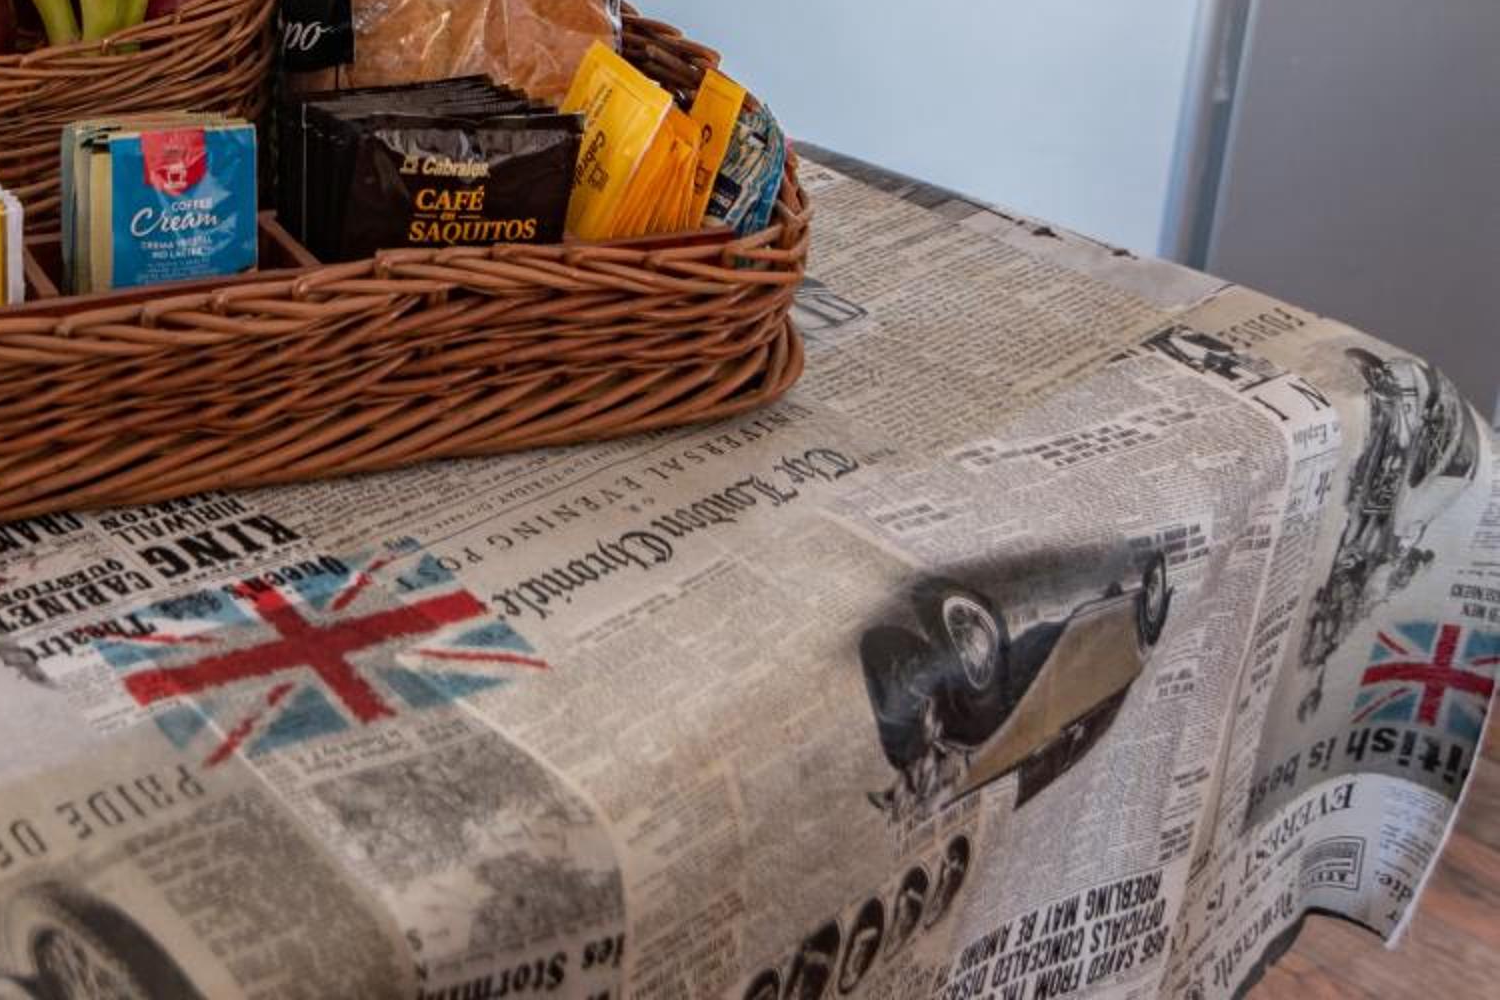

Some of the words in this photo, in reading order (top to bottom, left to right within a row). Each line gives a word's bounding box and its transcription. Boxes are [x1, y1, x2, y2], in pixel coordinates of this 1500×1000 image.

[171, 199, 213, 212] COFFEE
[416, 185, 485, 211] CAFÉ
[130, 208, 218, 237] Cream
[409, 218, 537, 244] SAQUITOS
[137, 513, 302, 579] KING
[56, 764, 205, 840] PRIDE
